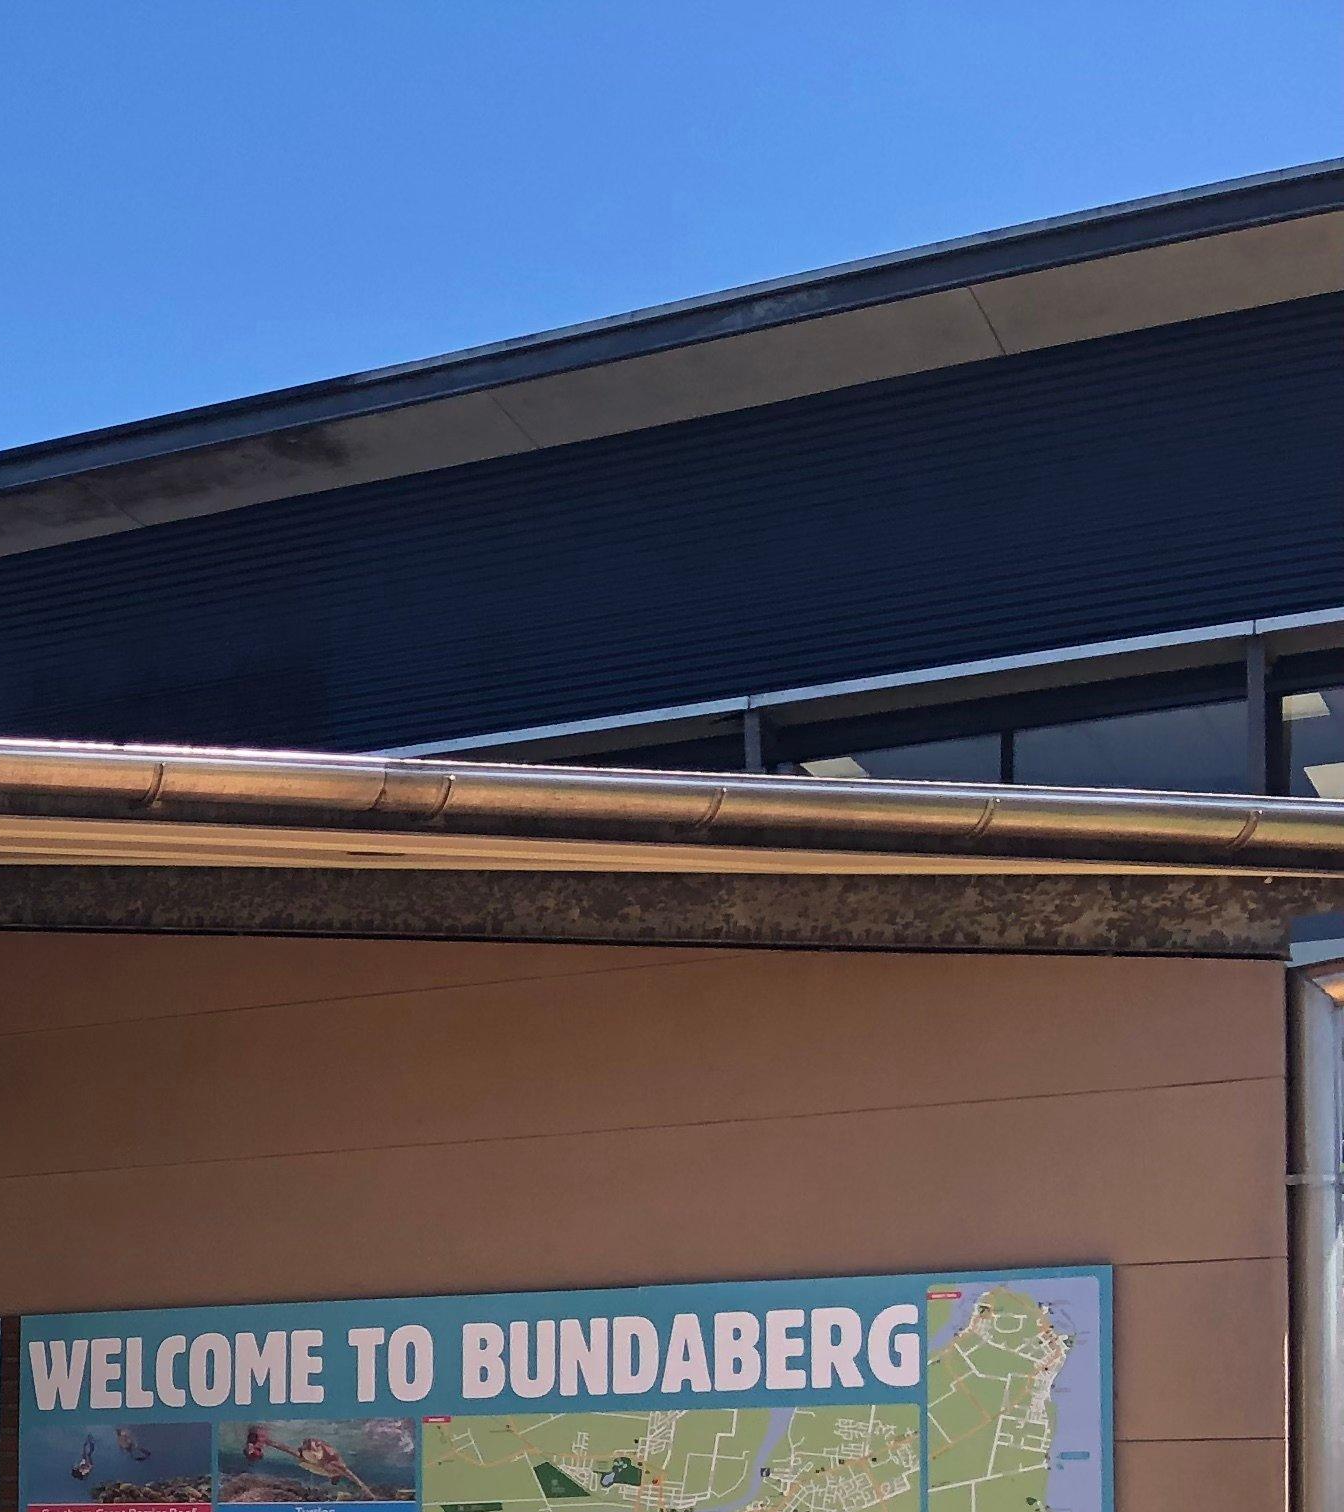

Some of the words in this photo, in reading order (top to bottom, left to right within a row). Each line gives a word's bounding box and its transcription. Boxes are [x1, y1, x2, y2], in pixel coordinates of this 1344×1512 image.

[28, 1329, 324, 1411] WELCOME
[347, 1324, 435, 1403] TO
[462, 1304, 920, 1400] BUNDABERG
